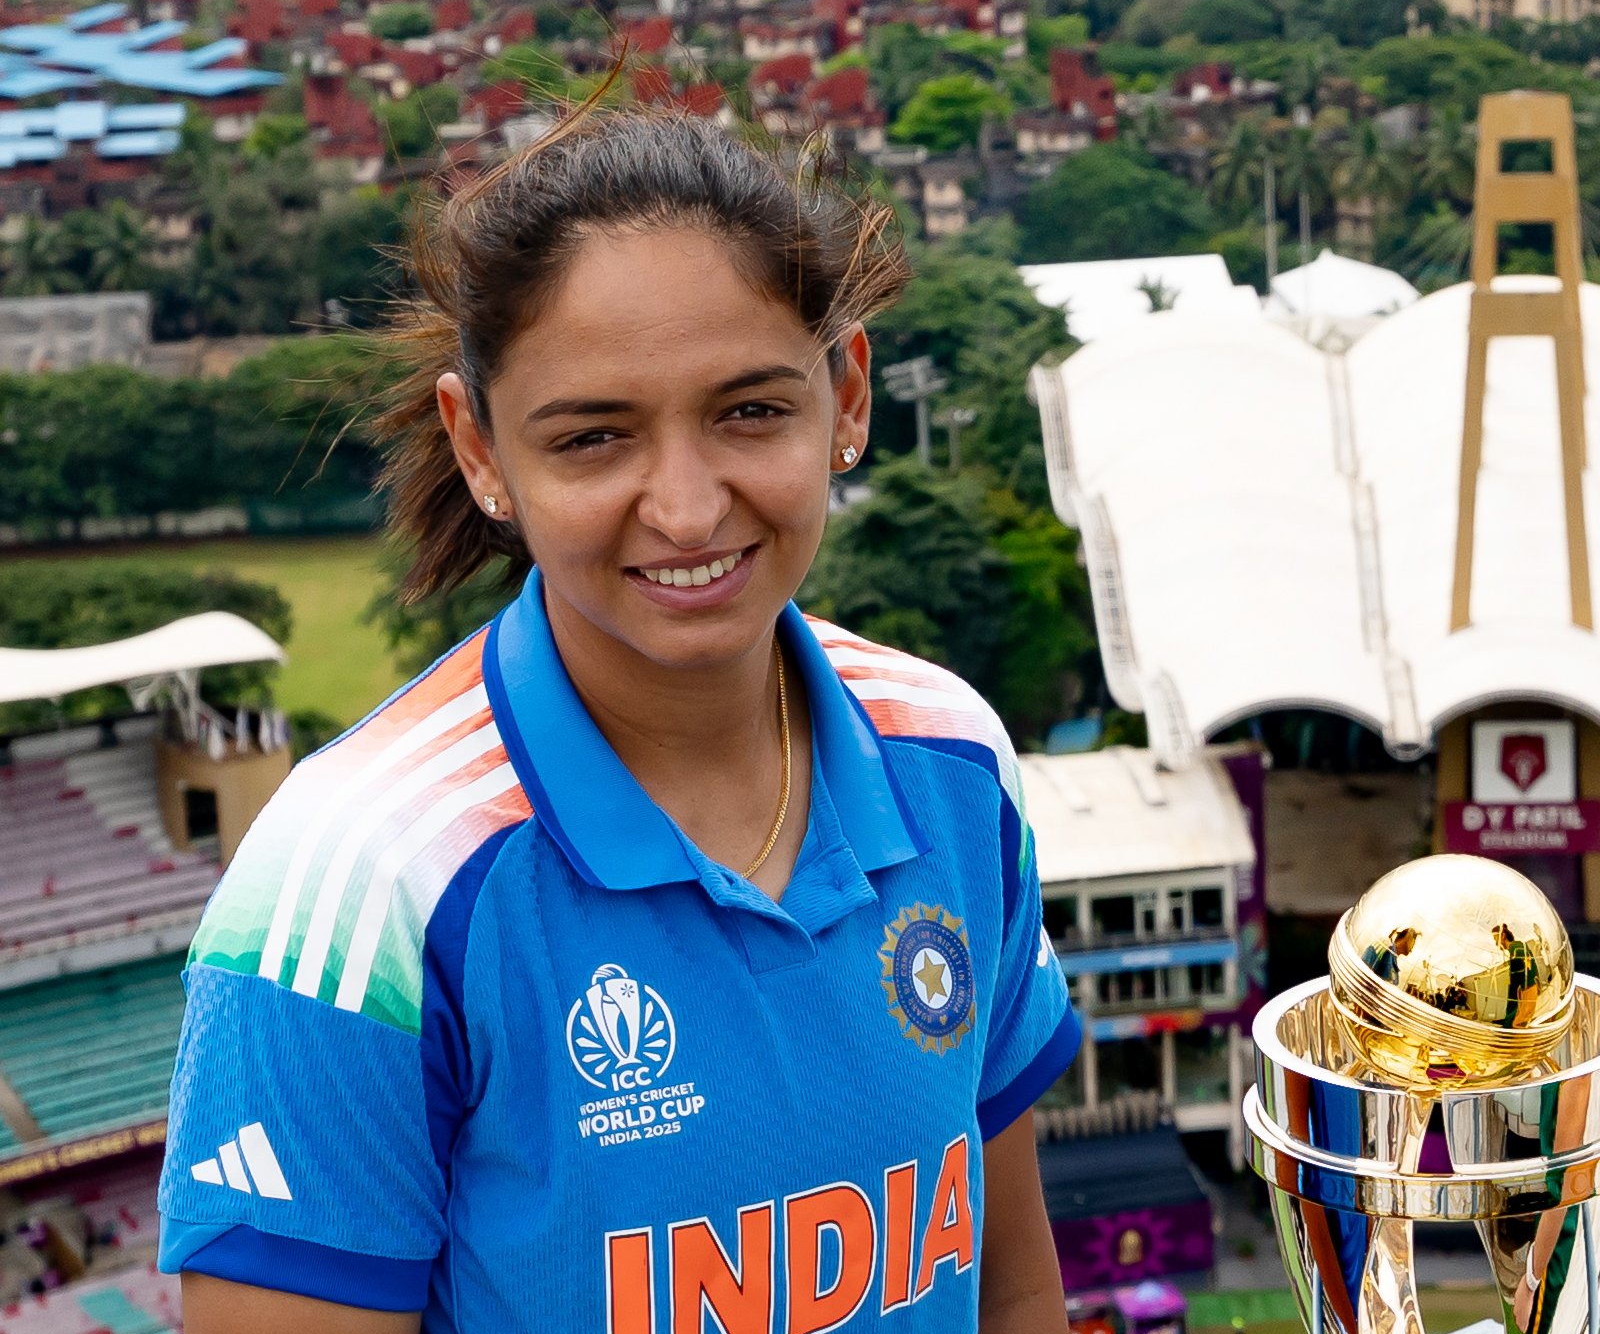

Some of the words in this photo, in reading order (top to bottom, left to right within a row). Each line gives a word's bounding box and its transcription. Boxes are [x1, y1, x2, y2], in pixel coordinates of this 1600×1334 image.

[611, 1067, 652, 1091] ICC
[579, 1094, 637, 1116] WOMEN'S
[640, 1082, 695, 1102] CRICKET
[578, 1106, 656, 1138] WORLD
[661, 1095, 705, 1119] CUP
[599, 1129, 642, 1147] INDIA
[644, 1121, 682, 1138] 2025
